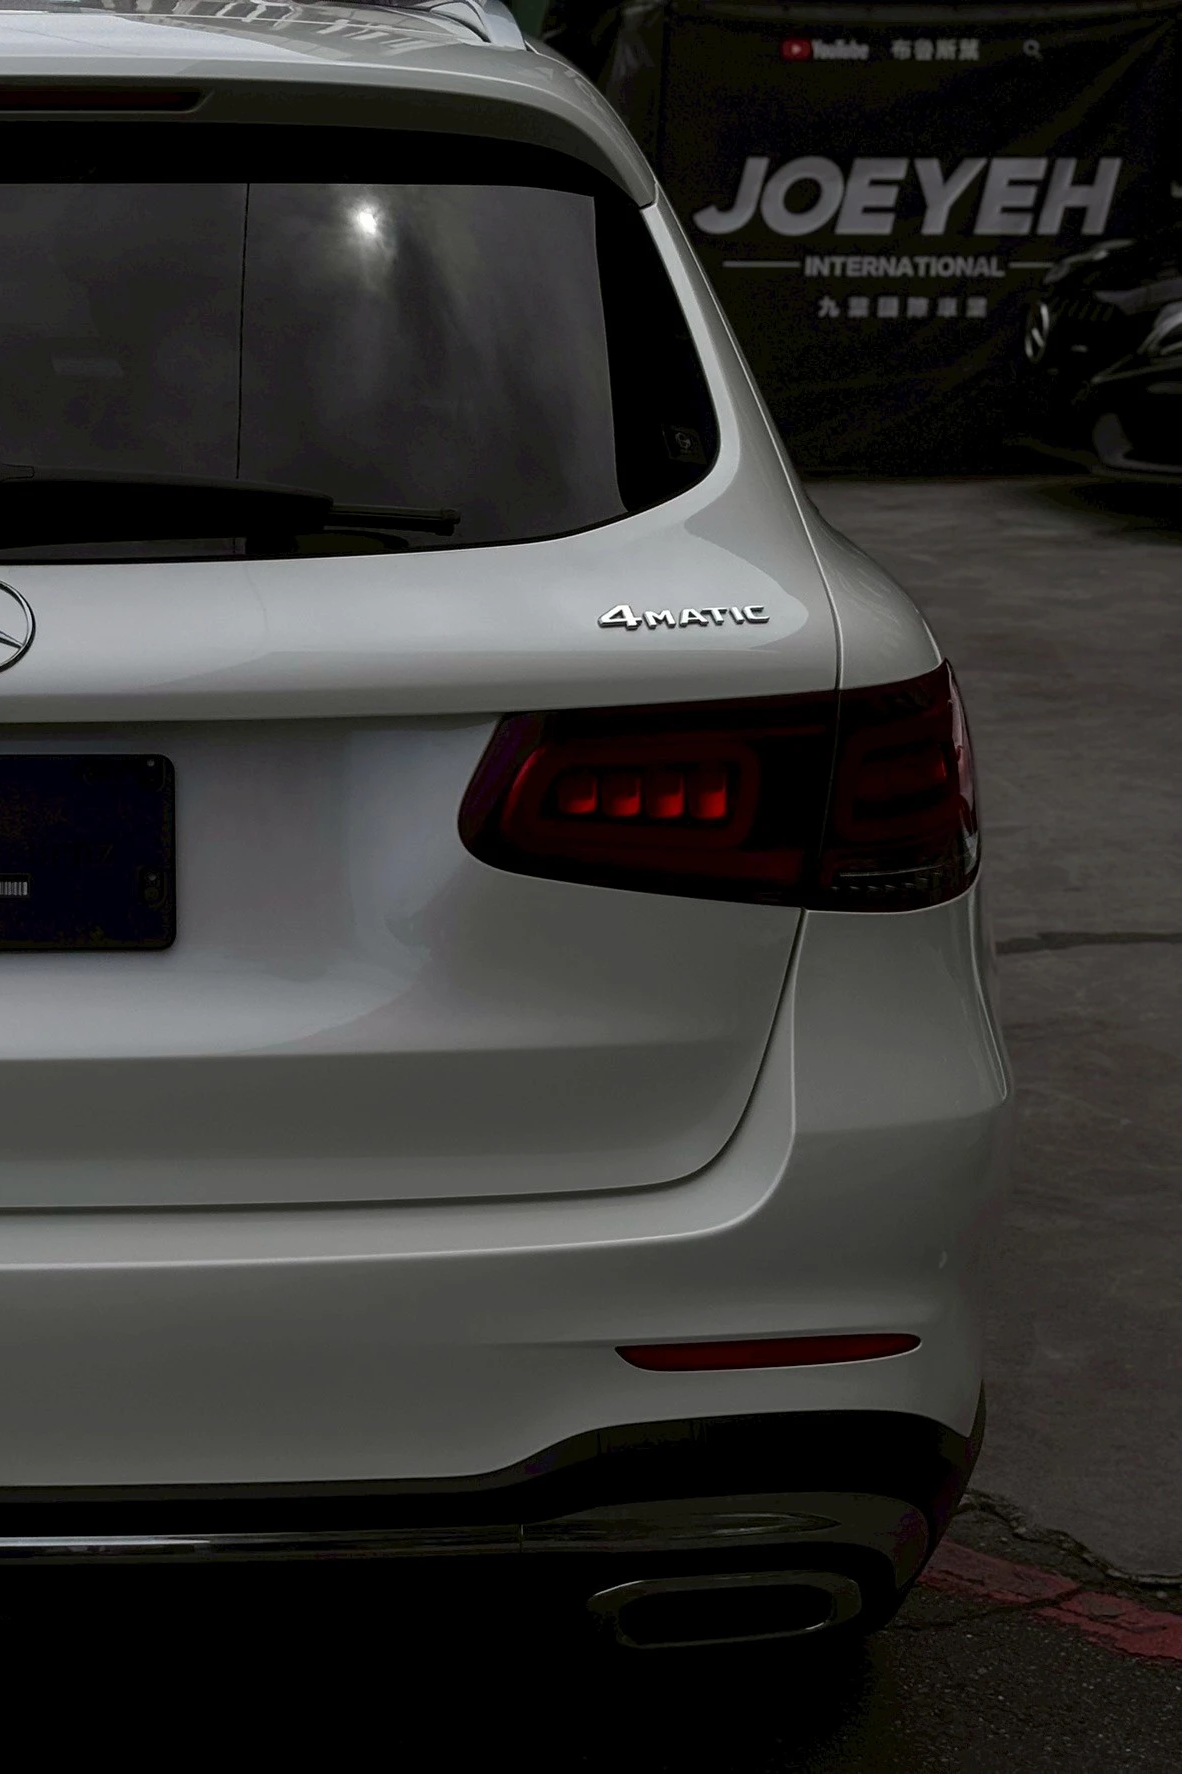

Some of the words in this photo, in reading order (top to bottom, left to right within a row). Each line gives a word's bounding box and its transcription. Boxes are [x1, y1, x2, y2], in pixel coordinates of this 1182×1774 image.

[692, 155, 1122, 237] JOEYEH
[804, 256, 1006, 278] INTERNATIONAL
[598, 604, 770, 631] 4MATIC
